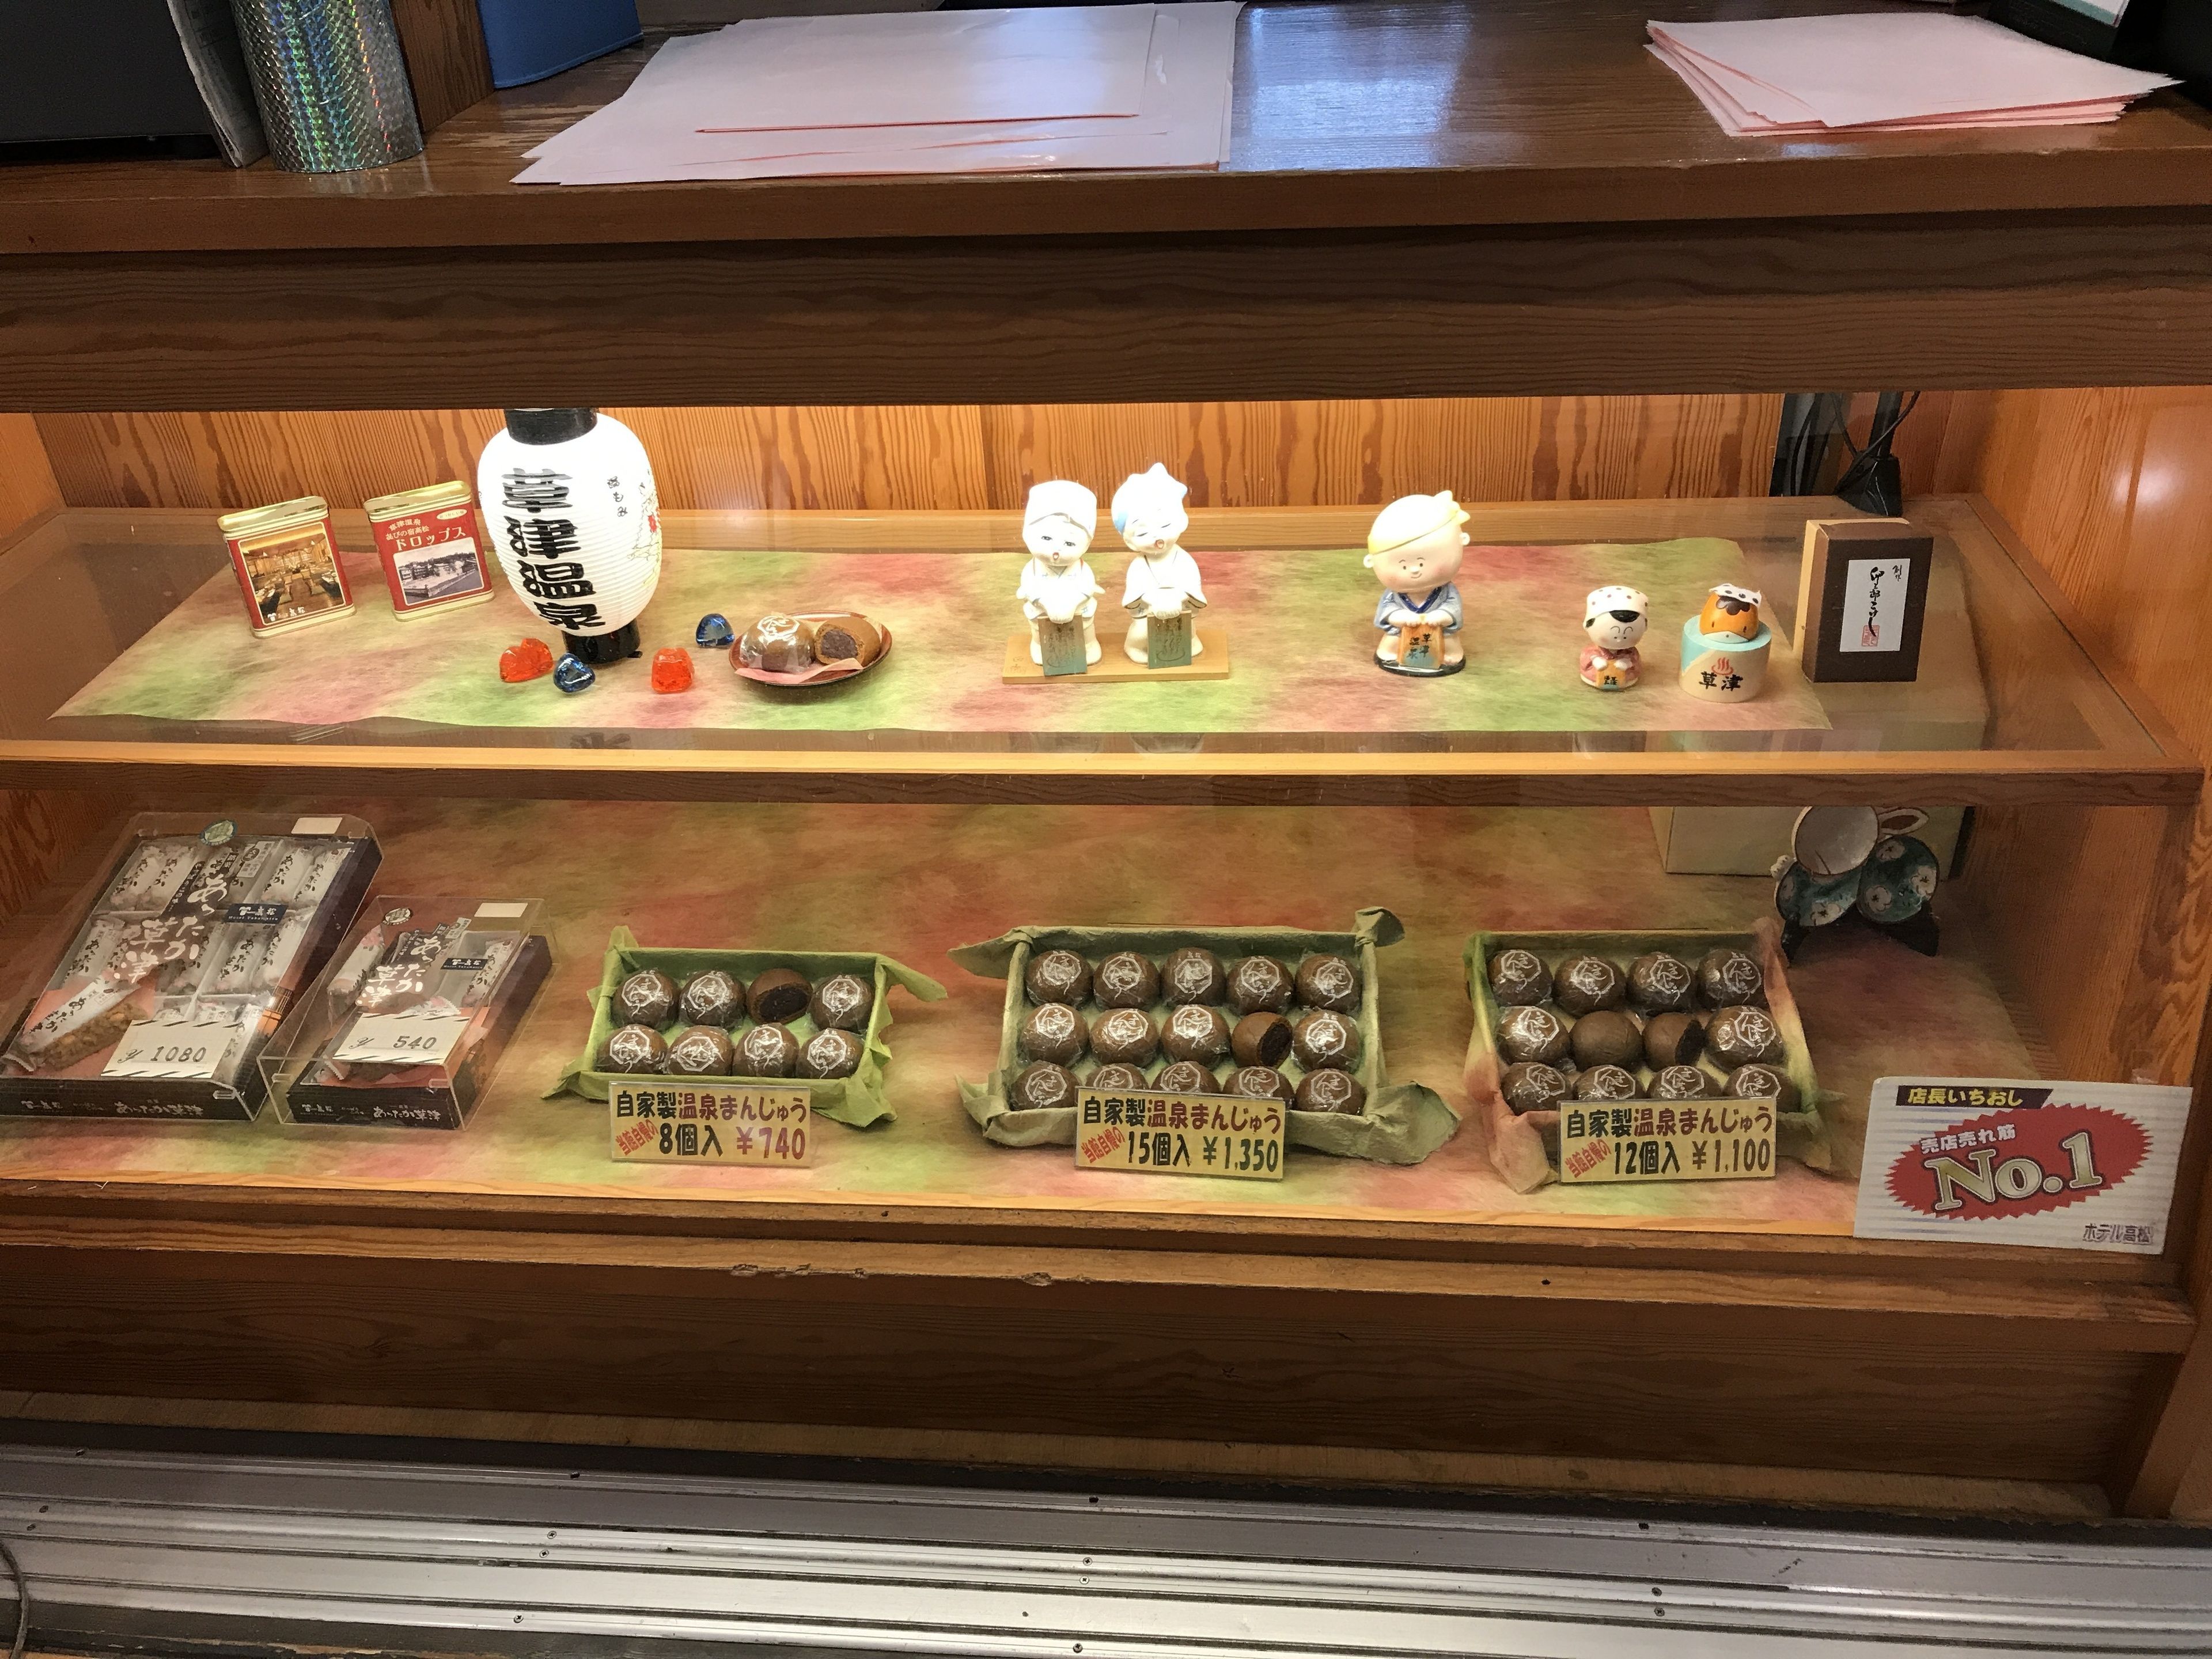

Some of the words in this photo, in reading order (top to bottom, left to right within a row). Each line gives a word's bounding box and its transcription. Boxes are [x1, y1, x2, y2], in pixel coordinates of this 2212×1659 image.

[388, 518, 422, 531] 草津温泉
[396, 526, 467, 551] ドロップス
[501, 468, 606, 630] 草津温泉
[1698, 671, 1744, 692] 草津
[150, 1046, 207, 1062] 1080
[393, 1036, 437, 1050] 540
[616, 1090, 807, 1123] 自家製温泉まんじゅう
[1907, 1088, 2024, 1107] 店長いちおし
[1083, 1096, 1282, 1135] 自家製温泉まんじゅう
[1566, 1105, 1773, 1139] 自家製温泉まんじゅう
[659, 1122, 724, 1157] 8個入
[736, 1126, 806, 1160] ¥740
[1128, 1131, 1191, 1167] 15個入
[1203, 1135, 1279, 1173] ¥1,350
[1919, 1123, 2017, 1154] 売店売れ筋
[1614, 1141, 1681, 1175] 12個入
[1692, 1138, 1771, 1173] ¥1,100
[1923, 1131, 2104, 1212] No.1
[2083, 1223, 2154, 1244] ホテル高松
